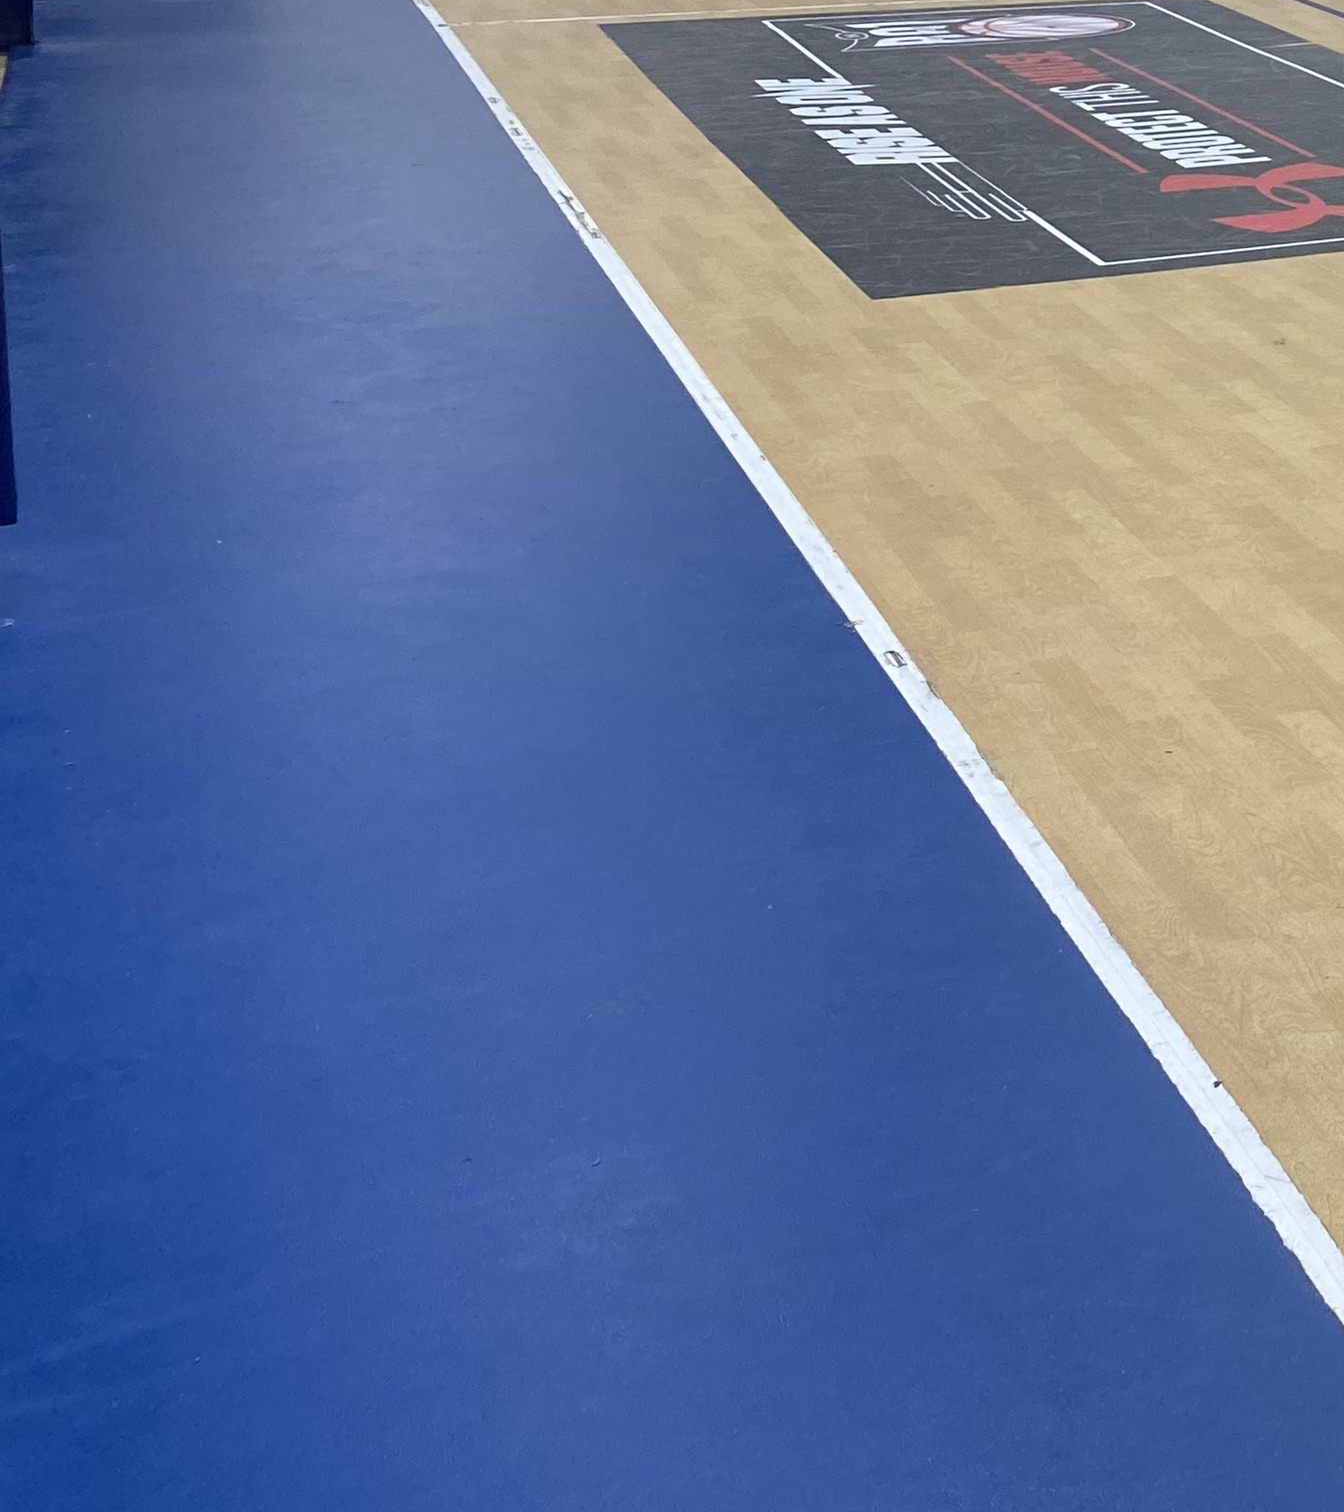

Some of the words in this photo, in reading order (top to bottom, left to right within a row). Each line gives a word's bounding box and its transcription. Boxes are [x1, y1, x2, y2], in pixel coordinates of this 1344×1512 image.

[985, 50, 1112, 86] HOUSE
[752, 76, 877, 105] ONE
[1050, 83, 1159, 111] THIS
[789, 104, 907, 126] AS
[813, 126, 959, 166] RISE
[1092, 109, 1271, 169] PROTECT
